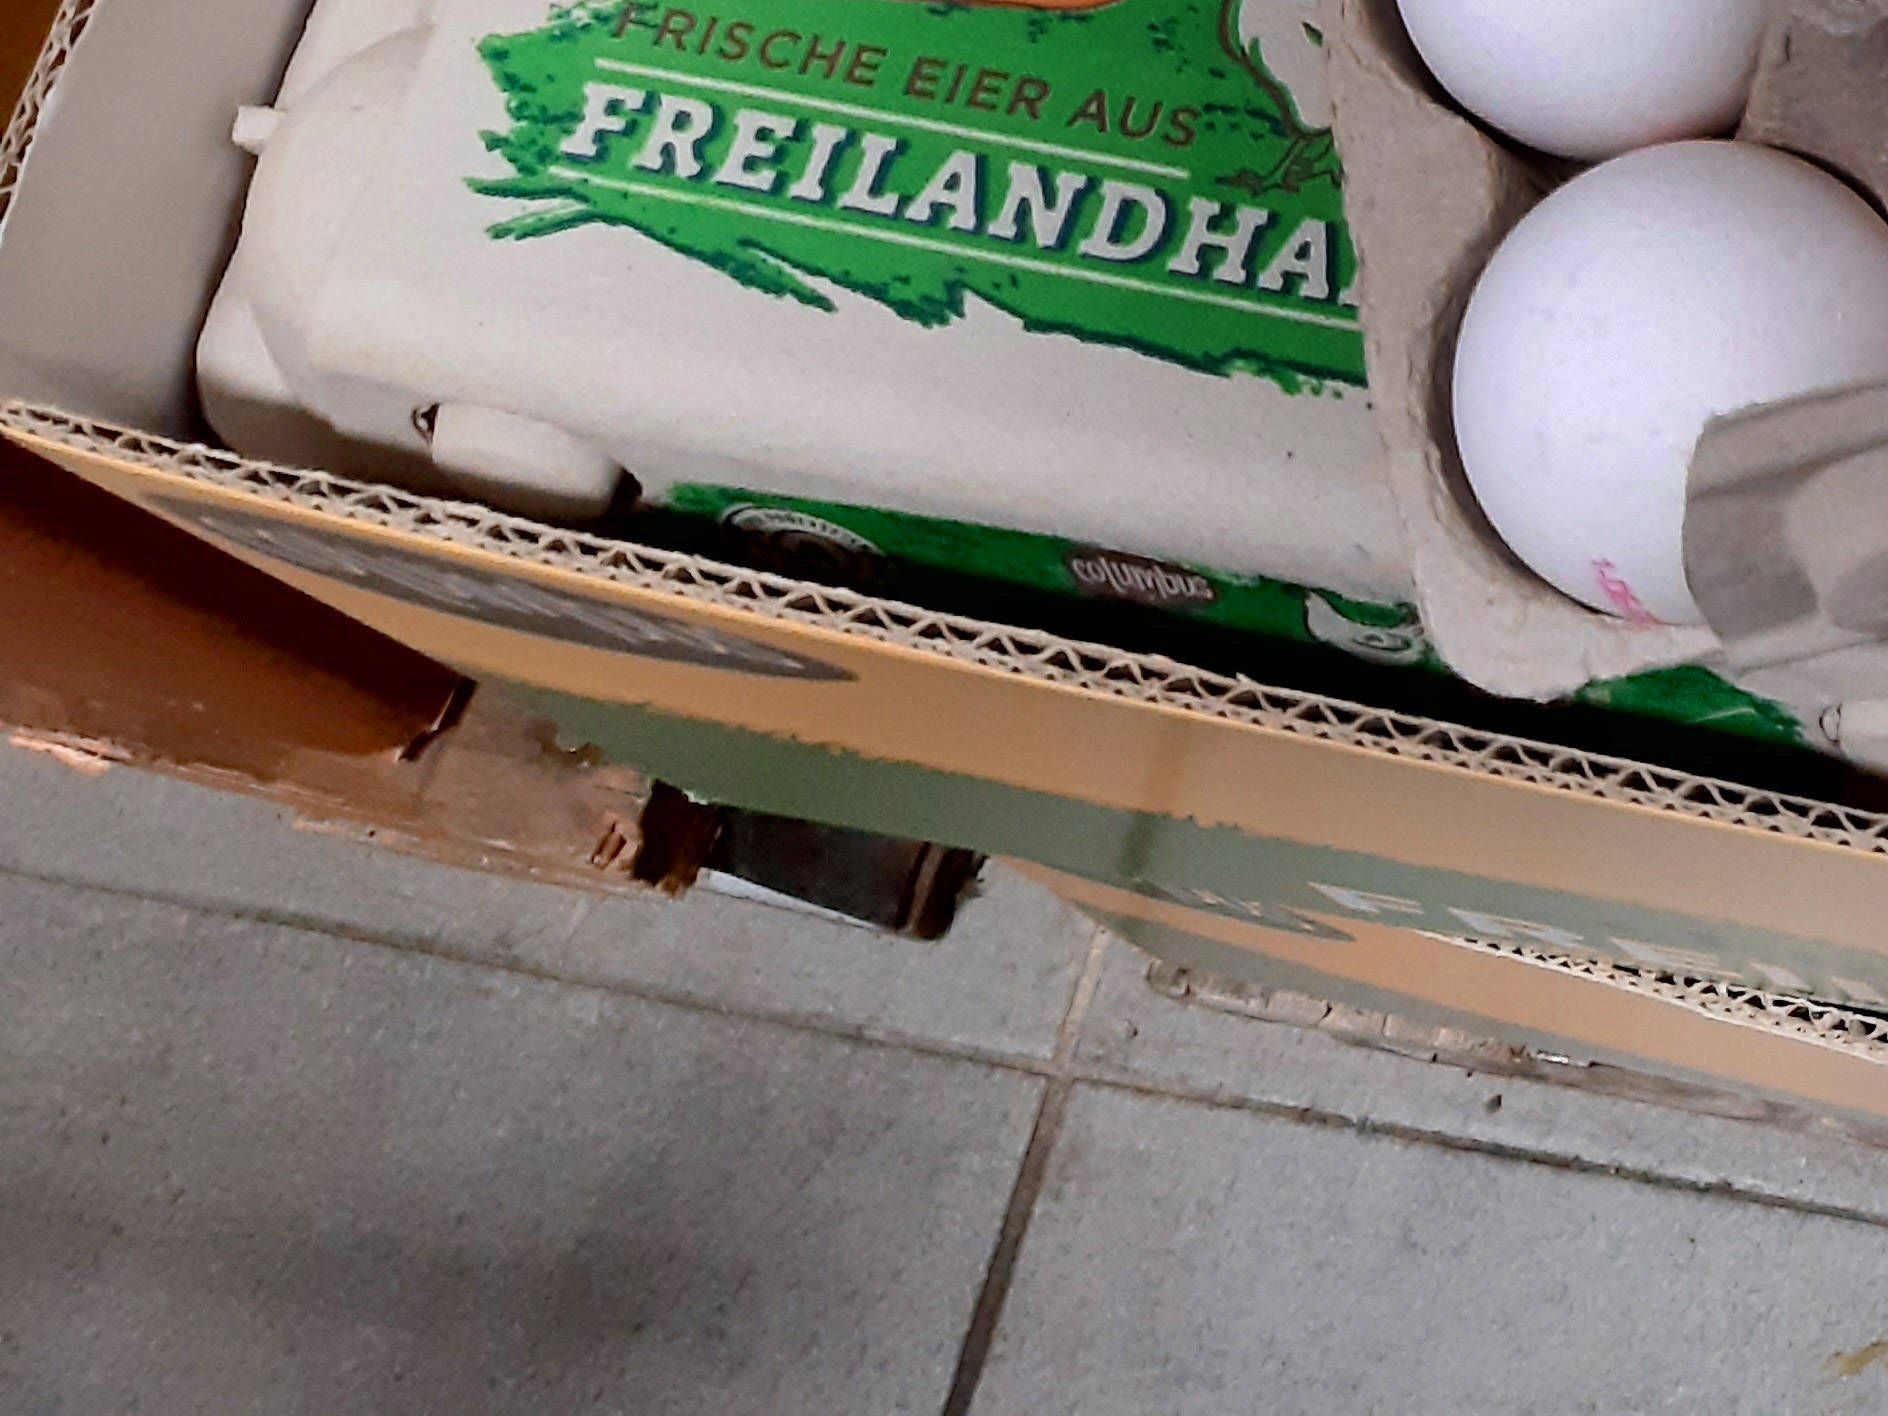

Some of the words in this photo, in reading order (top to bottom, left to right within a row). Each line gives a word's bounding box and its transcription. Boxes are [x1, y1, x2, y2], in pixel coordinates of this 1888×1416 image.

[607, 0, 888, 92] FRISCHE
[901, 55, 1051, 120] EIER
[1065, 90, 1202, 152] AUS
[558, 78, 1358, 308] FREILANDHA
[1071, 550, 1214, 605] columbus
